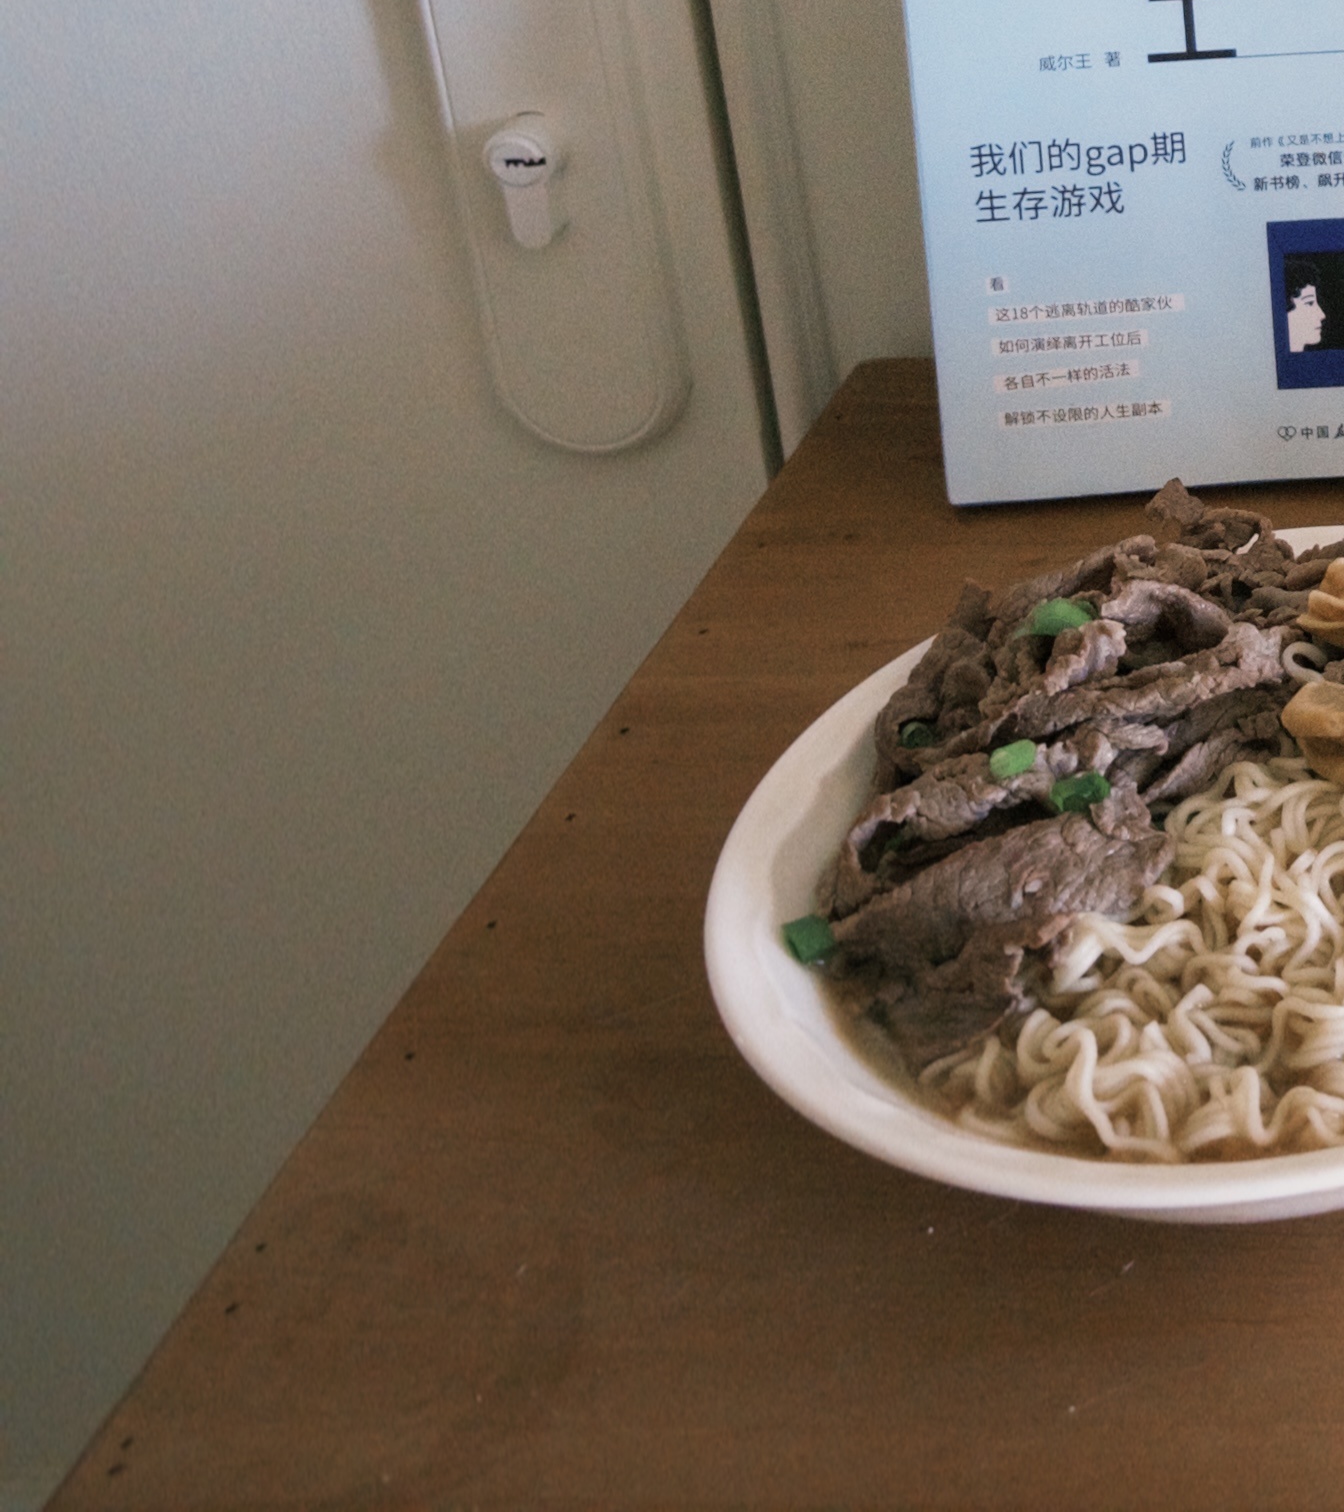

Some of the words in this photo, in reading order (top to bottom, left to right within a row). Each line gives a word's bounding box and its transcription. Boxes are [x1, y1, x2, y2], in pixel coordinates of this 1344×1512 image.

[1039, 53, 1092, 71] 威尔王
[1104, 51, 1121, 67] 著
[970, 132, 1186, 177] 我们的gap期
[975, 181, 1125, 223] 生存游戏
[995, 296, 1174, 322] 这18个逃离轨道的酷家伙
[999, 330, 1141, 354] 如何演绎离开工位后
[1004, 362, 1131, 391] 各自不一样的活法
[1004, 400, 1164, 426] 解锁不设限的人生副本
